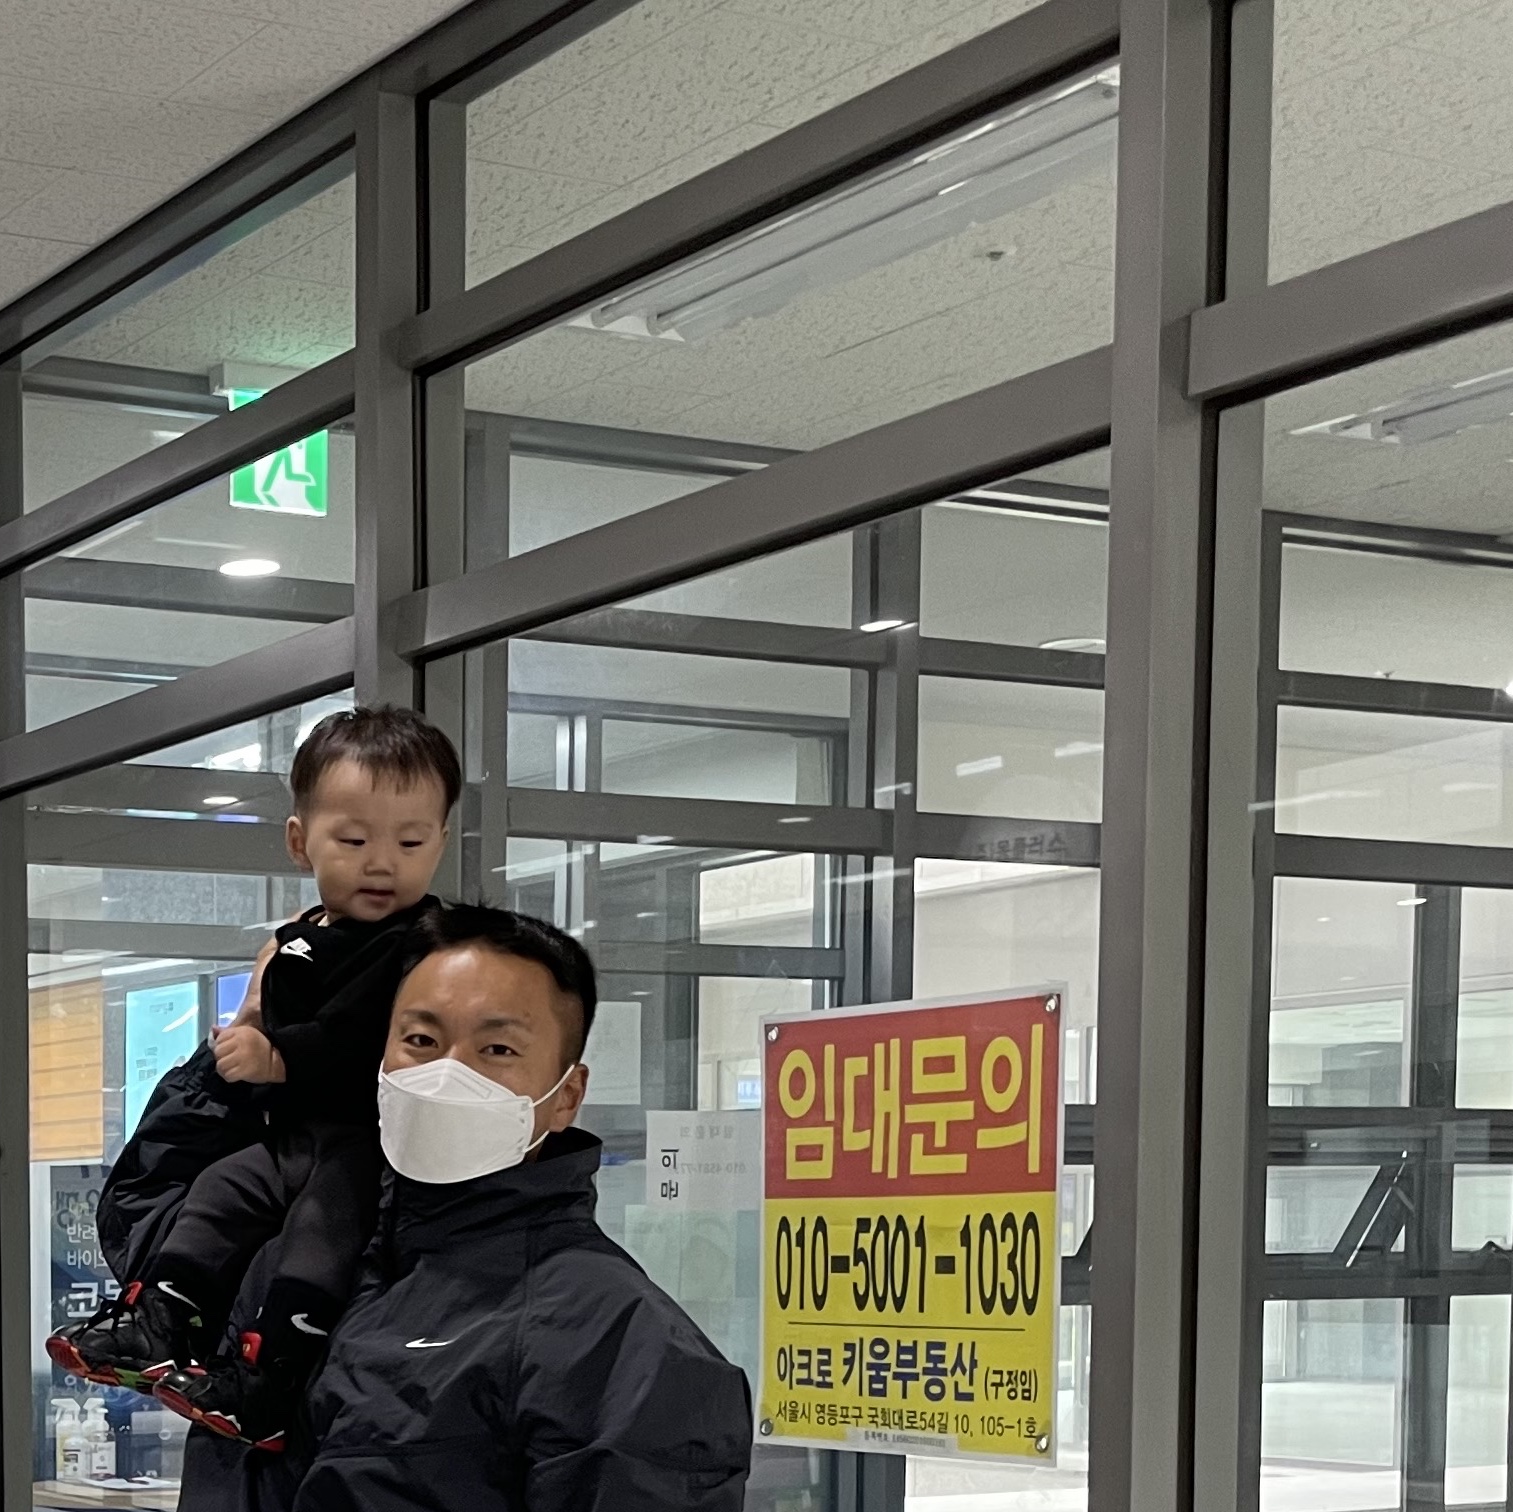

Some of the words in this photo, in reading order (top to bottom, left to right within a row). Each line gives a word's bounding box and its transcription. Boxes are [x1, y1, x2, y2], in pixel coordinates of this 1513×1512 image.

[778, 1023, 1044, 1180] 임대문의
[776, 1211, 1040, 1316] 010-5001-1030
[777, 1344, 832, 1391] 아크로
[842, 1336, 977, 1402] 키움부동산
[984, 1366, 1038, 1404] (구정임)
[776, 1400, 812, 1425] 서울시
[815, 1403, 864, 1428] 영등포구
[867, 1406, 948, 1435] 국회대로54길
[954, 1414, 973, 1438] 10,
[981, 1416, 1038, 1439] 105-1호
